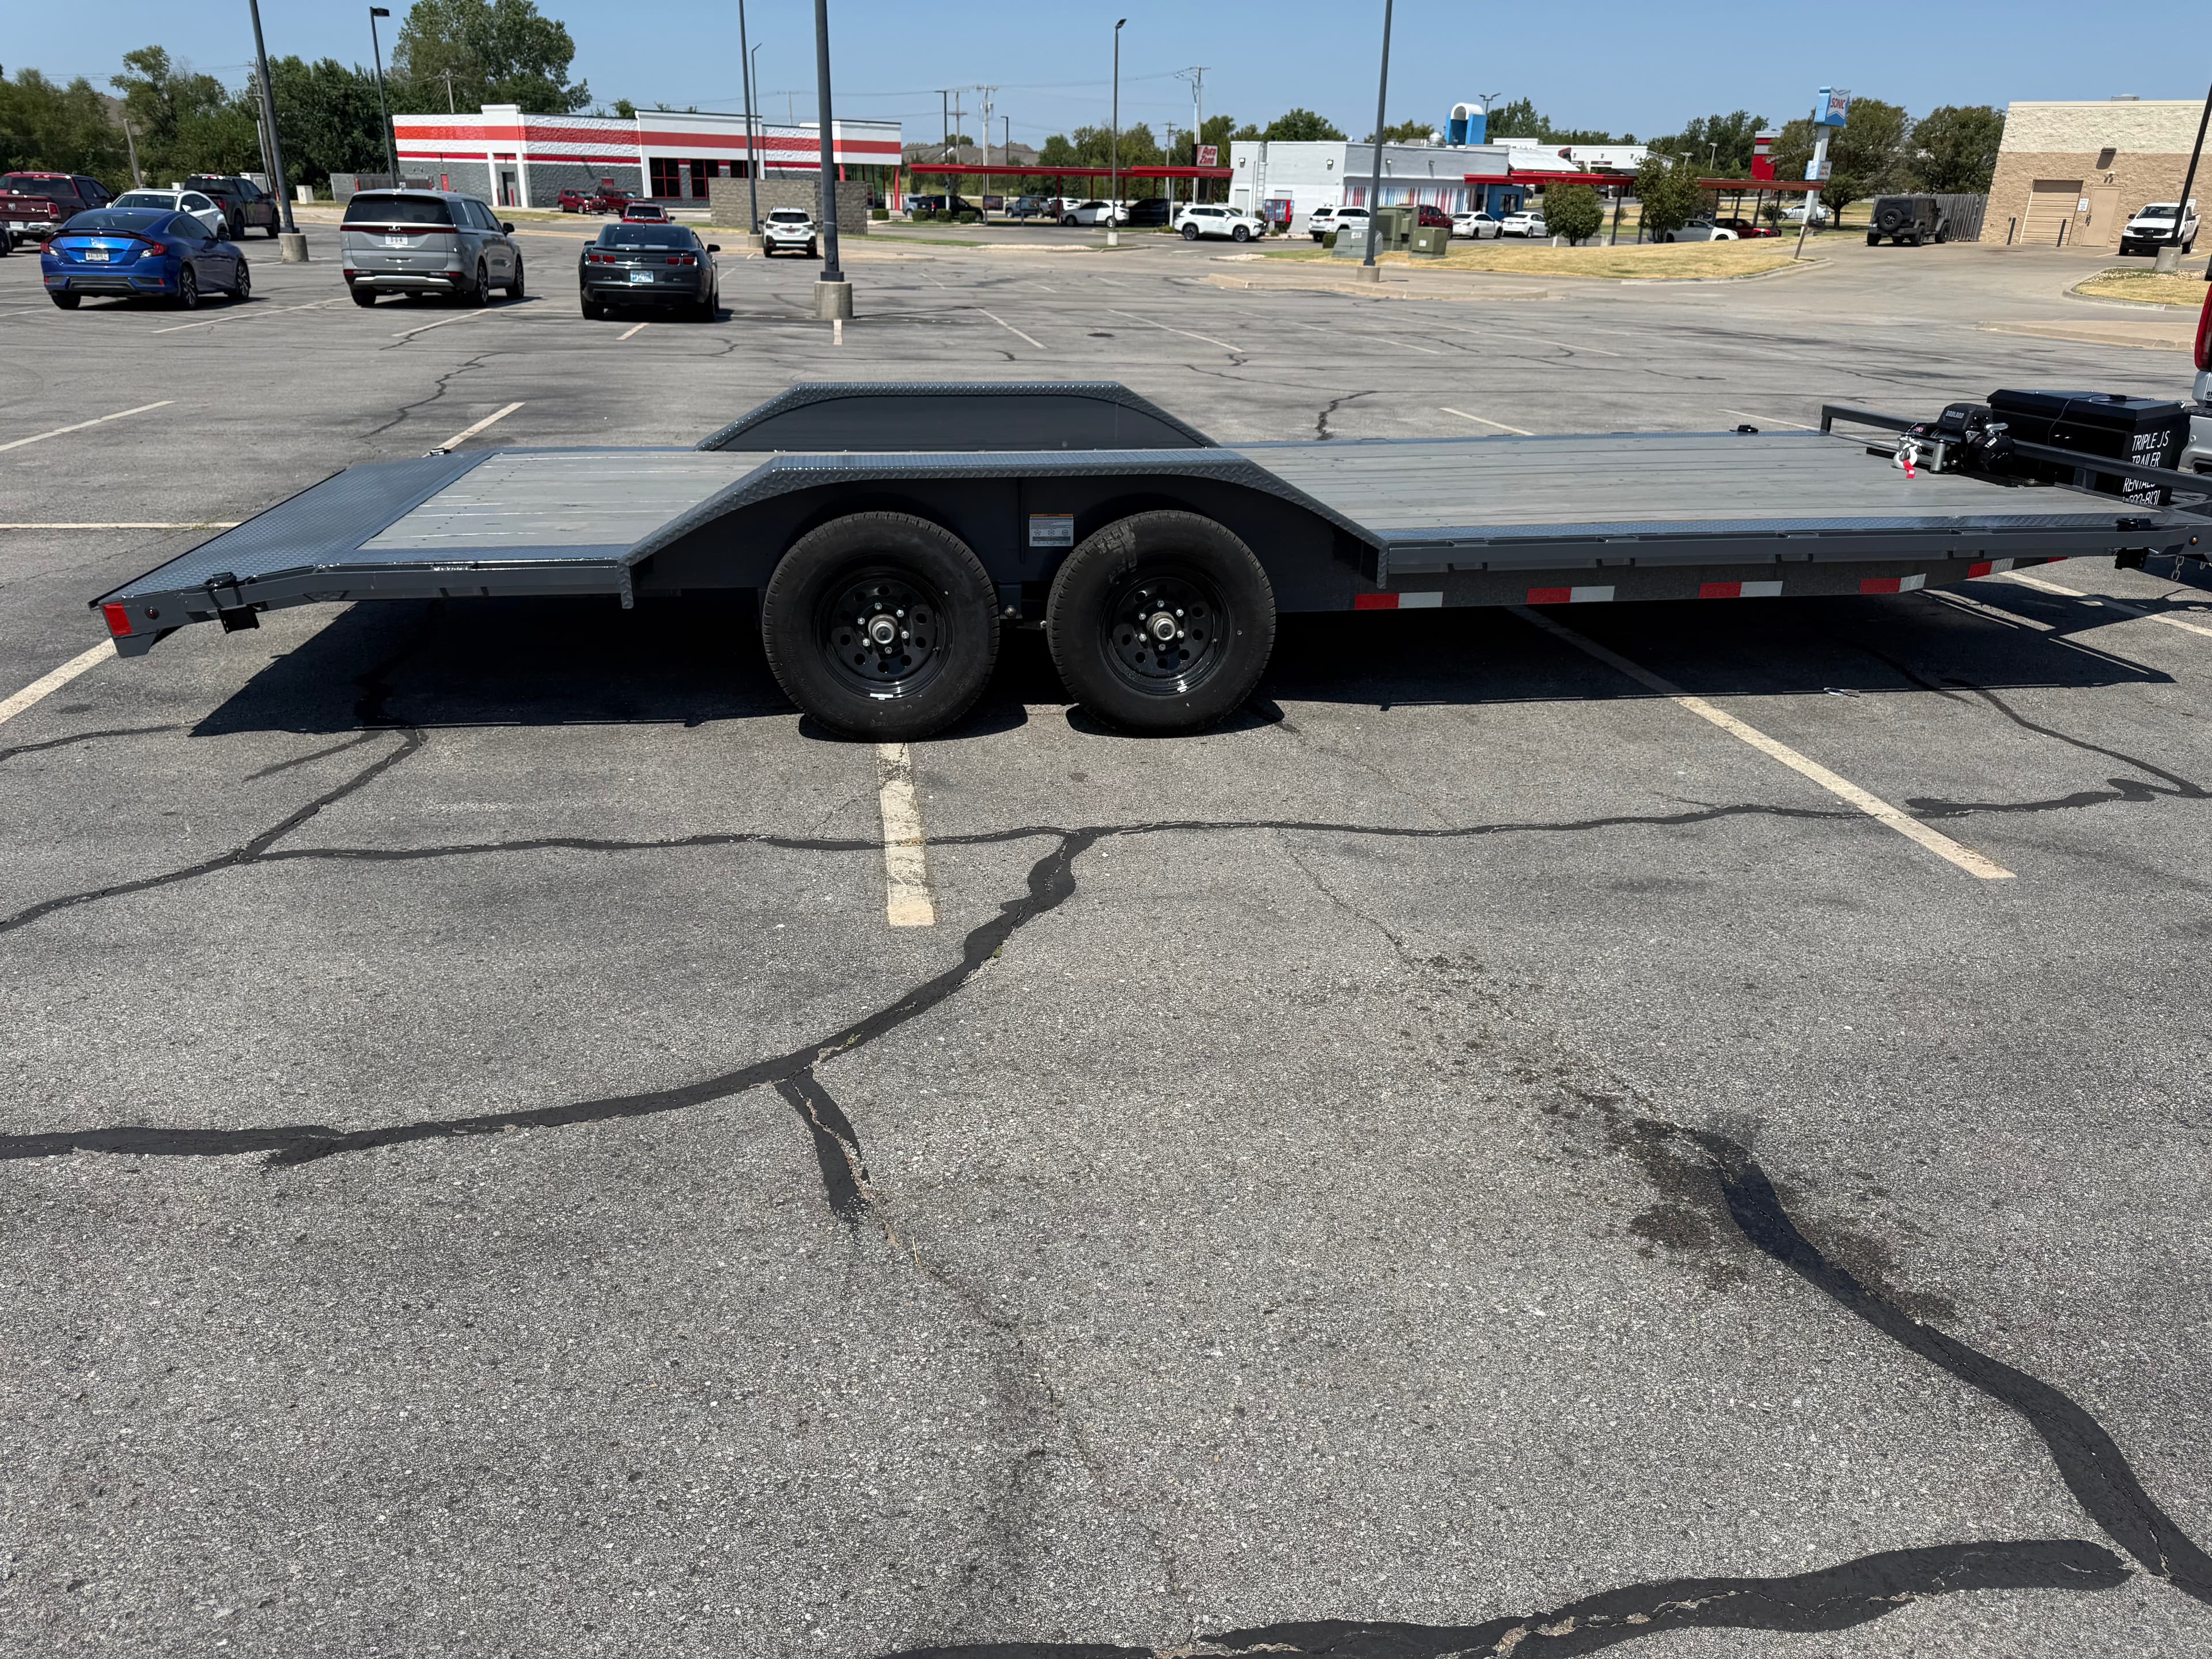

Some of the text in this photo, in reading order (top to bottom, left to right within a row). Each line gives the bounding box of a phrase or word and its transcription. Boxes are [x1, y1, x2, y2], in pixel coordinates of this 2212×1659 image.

[1830, 97, 1846, 109] SONIC
[2132, 430, 2170, 452] TRIPLE JS
